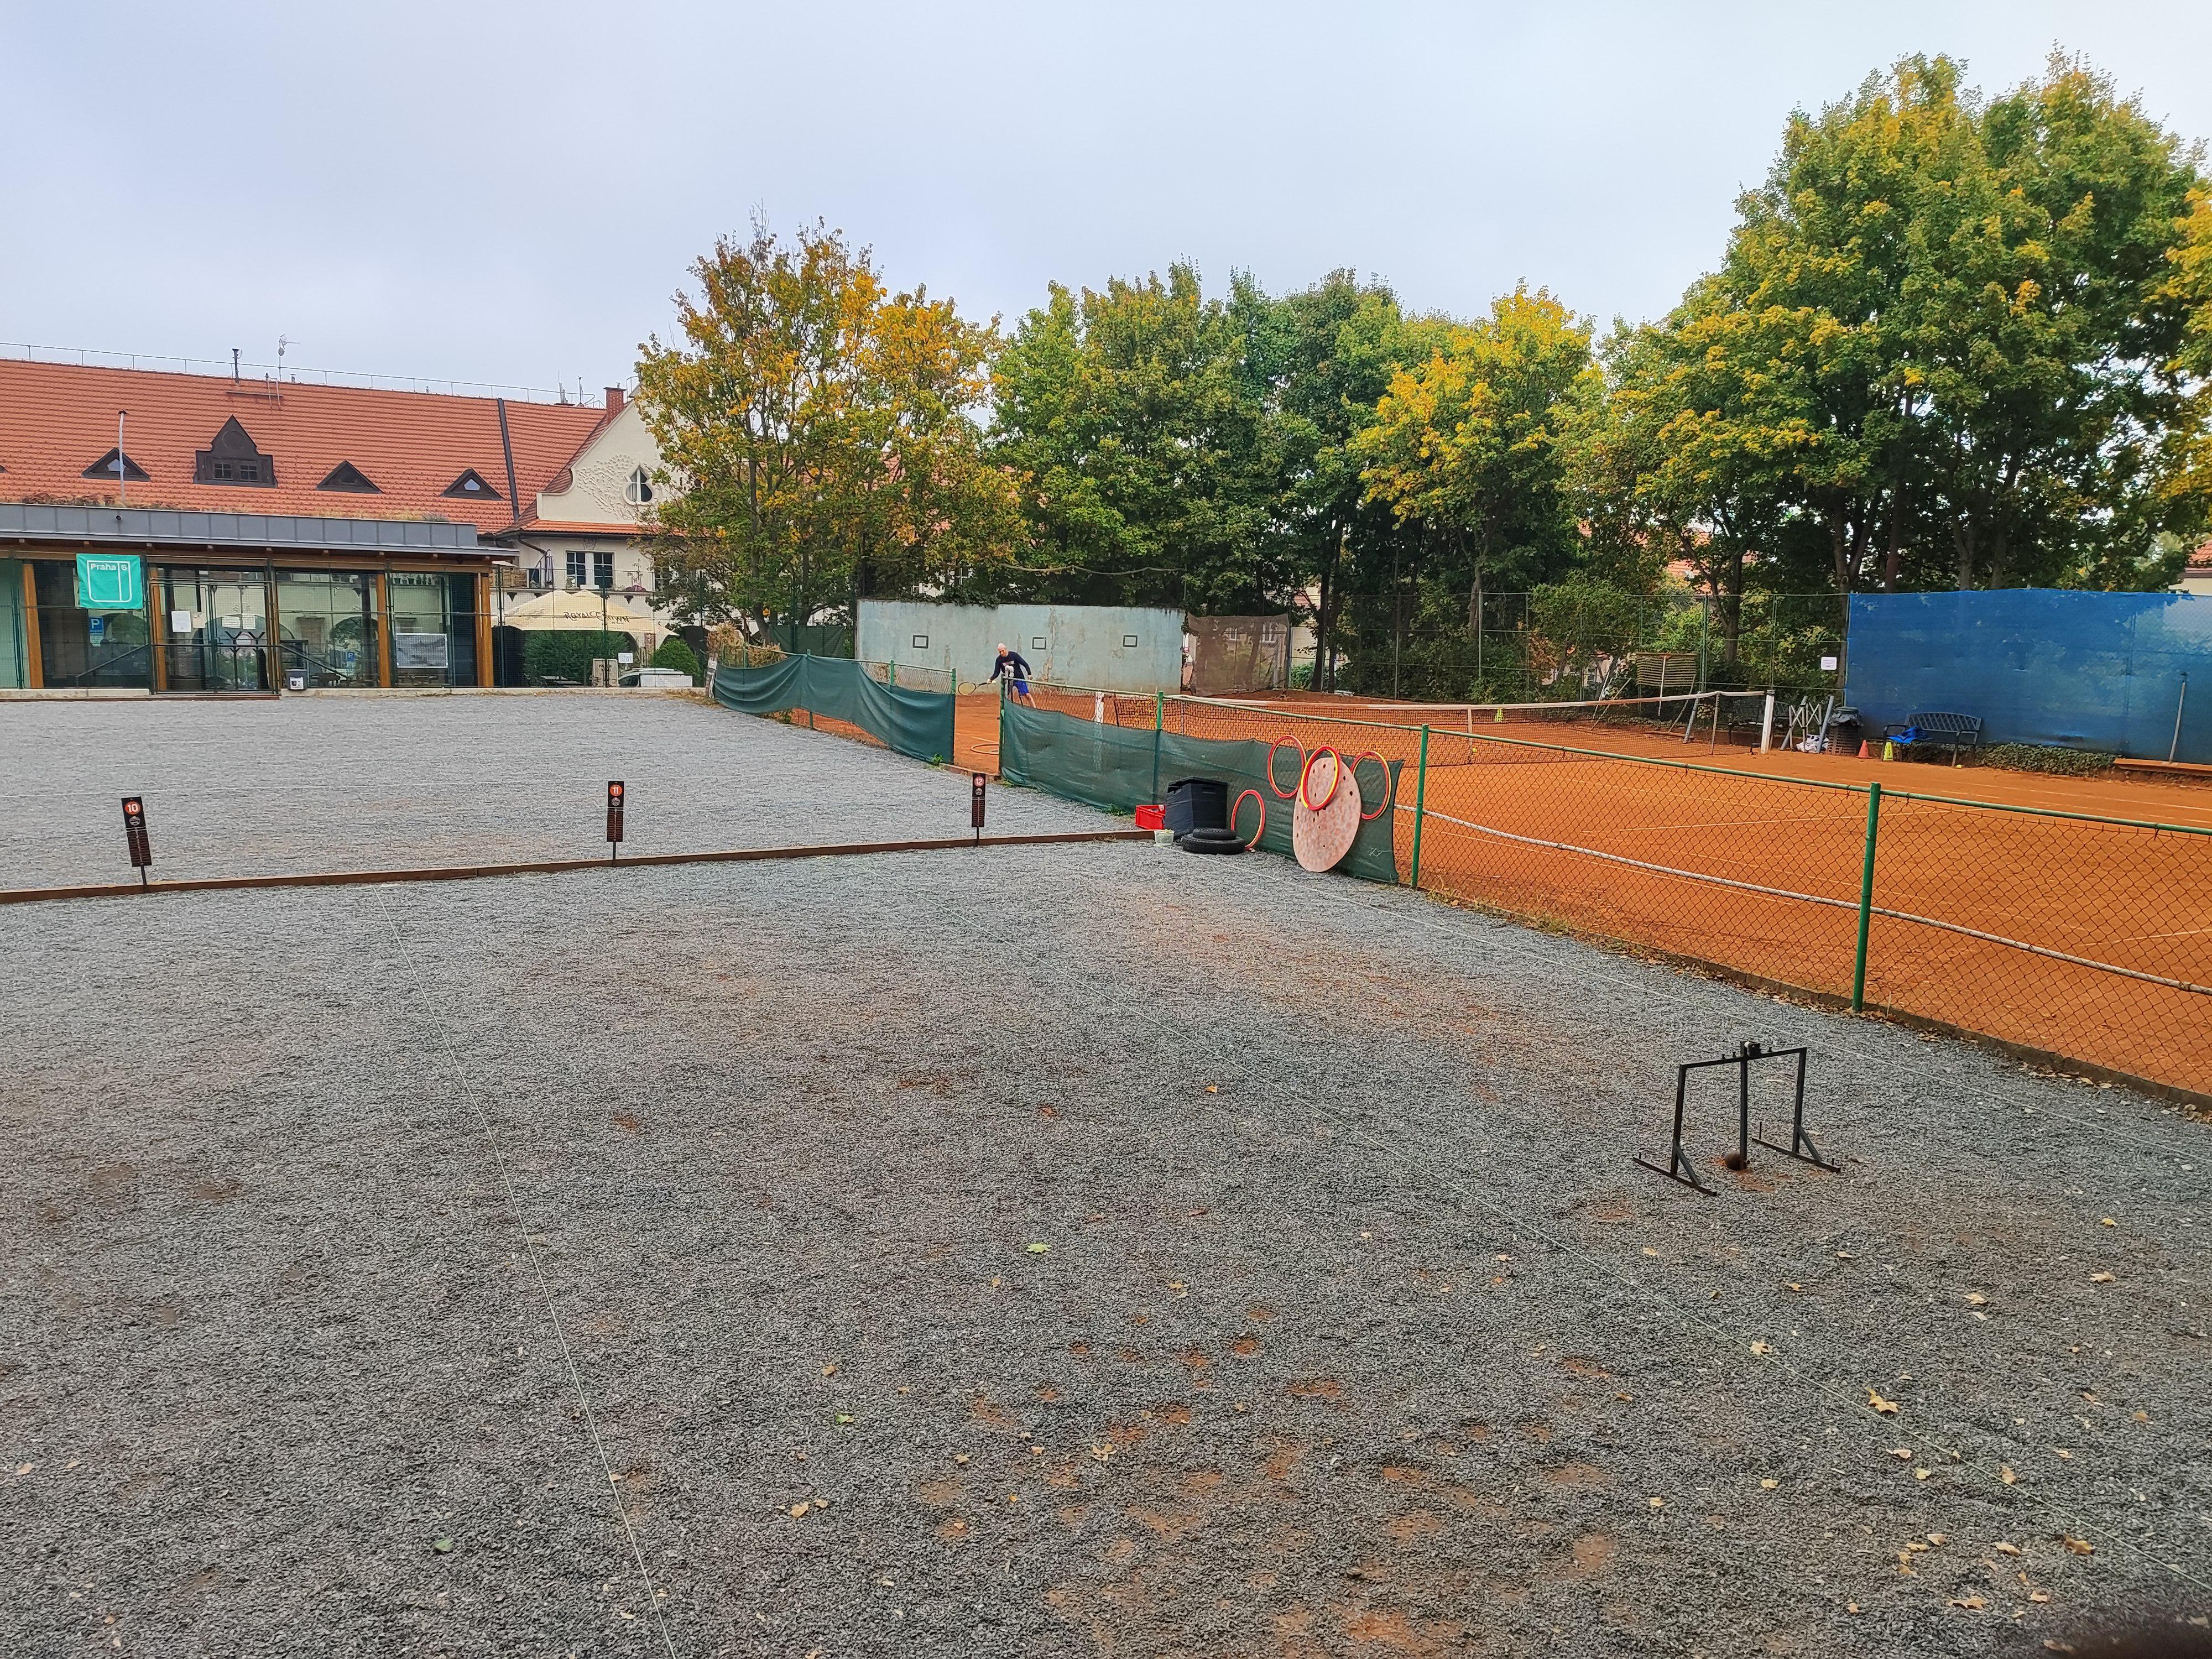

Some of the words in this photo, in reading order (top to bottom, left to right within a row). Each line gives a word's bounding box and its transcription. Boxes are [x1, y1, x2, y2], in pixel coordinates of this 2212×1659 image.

[91, 618, 100, 629] P
[613, 786, 619, 795] 11
[127, 804, 138, 812] 10
